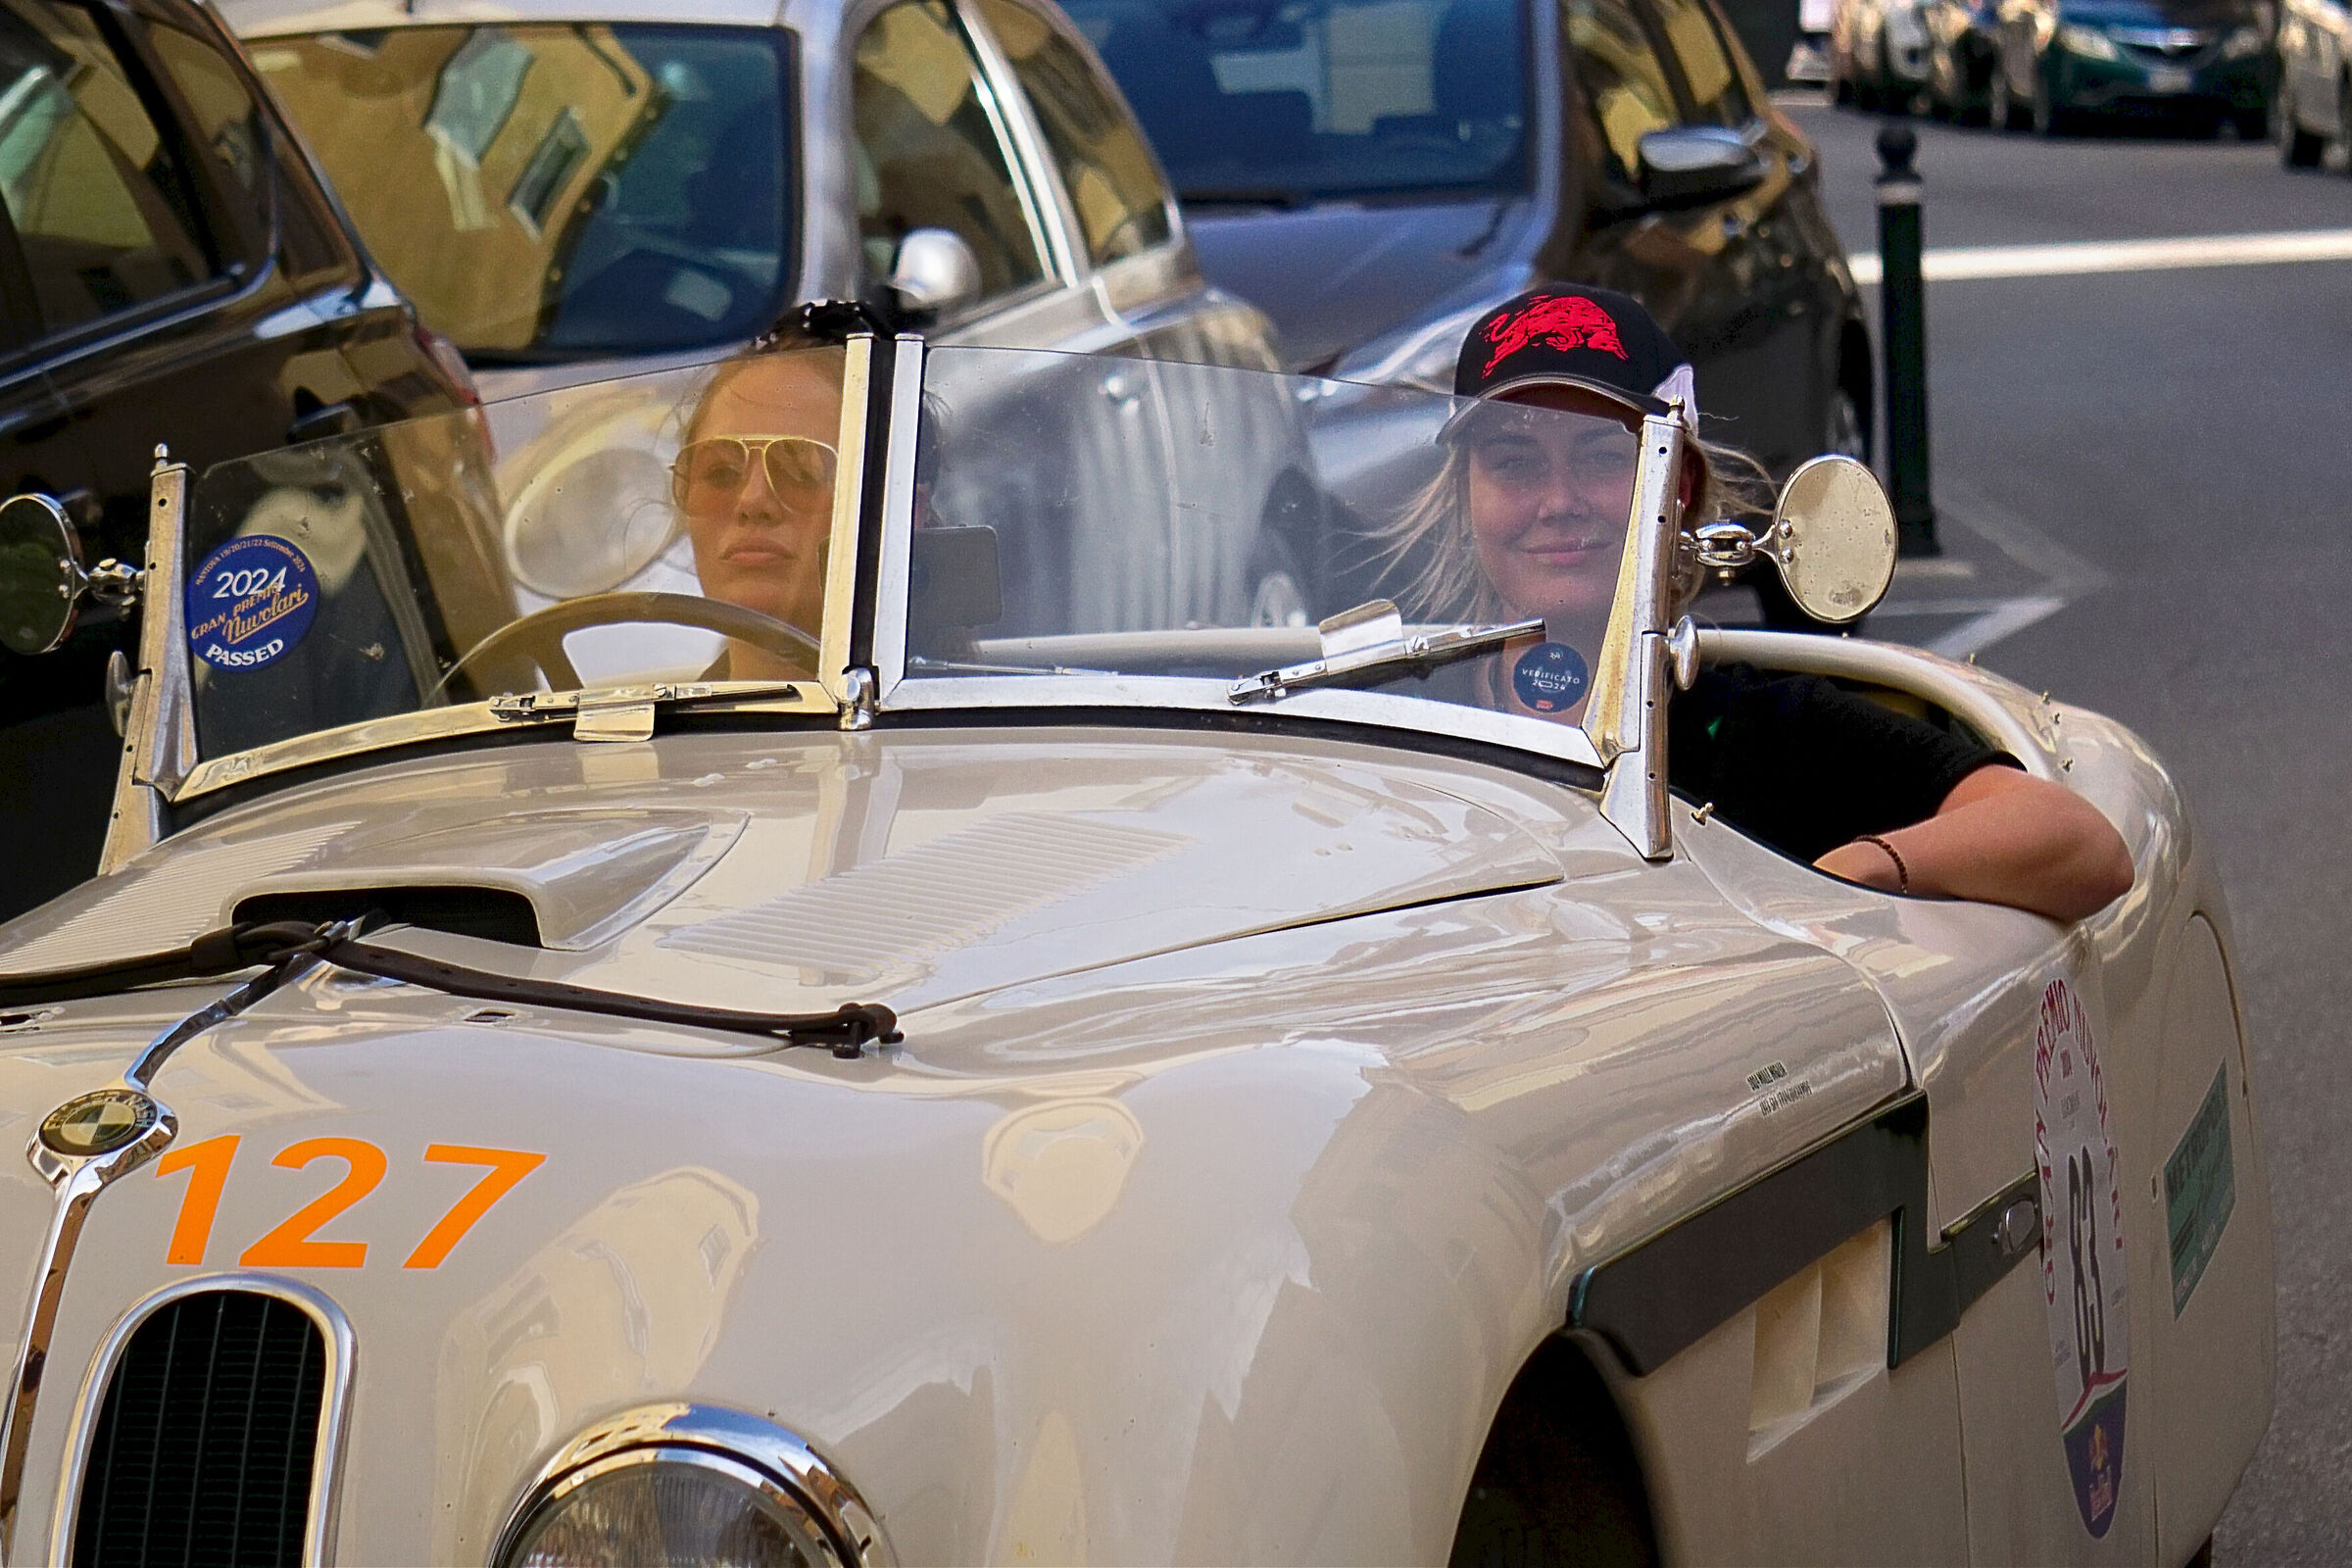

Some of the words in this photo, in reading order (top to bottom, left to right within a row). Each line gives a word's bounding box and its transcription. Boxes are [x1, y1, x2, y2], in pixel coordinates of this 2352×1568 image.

[213, 565, 287, 599] 2024
[191, 612, 226, 640] GRAN
[221, 582, 310, 644] Nuvolari
[206, 638, 284, 666] PASSED
[1522, 668, 1580, 684] VERIFICATO
[2035, 978, 2071, 1105] PREMIO
[155, 1134, 549, 1270] 127
[2068, 1145, 2105, 1391] 83
